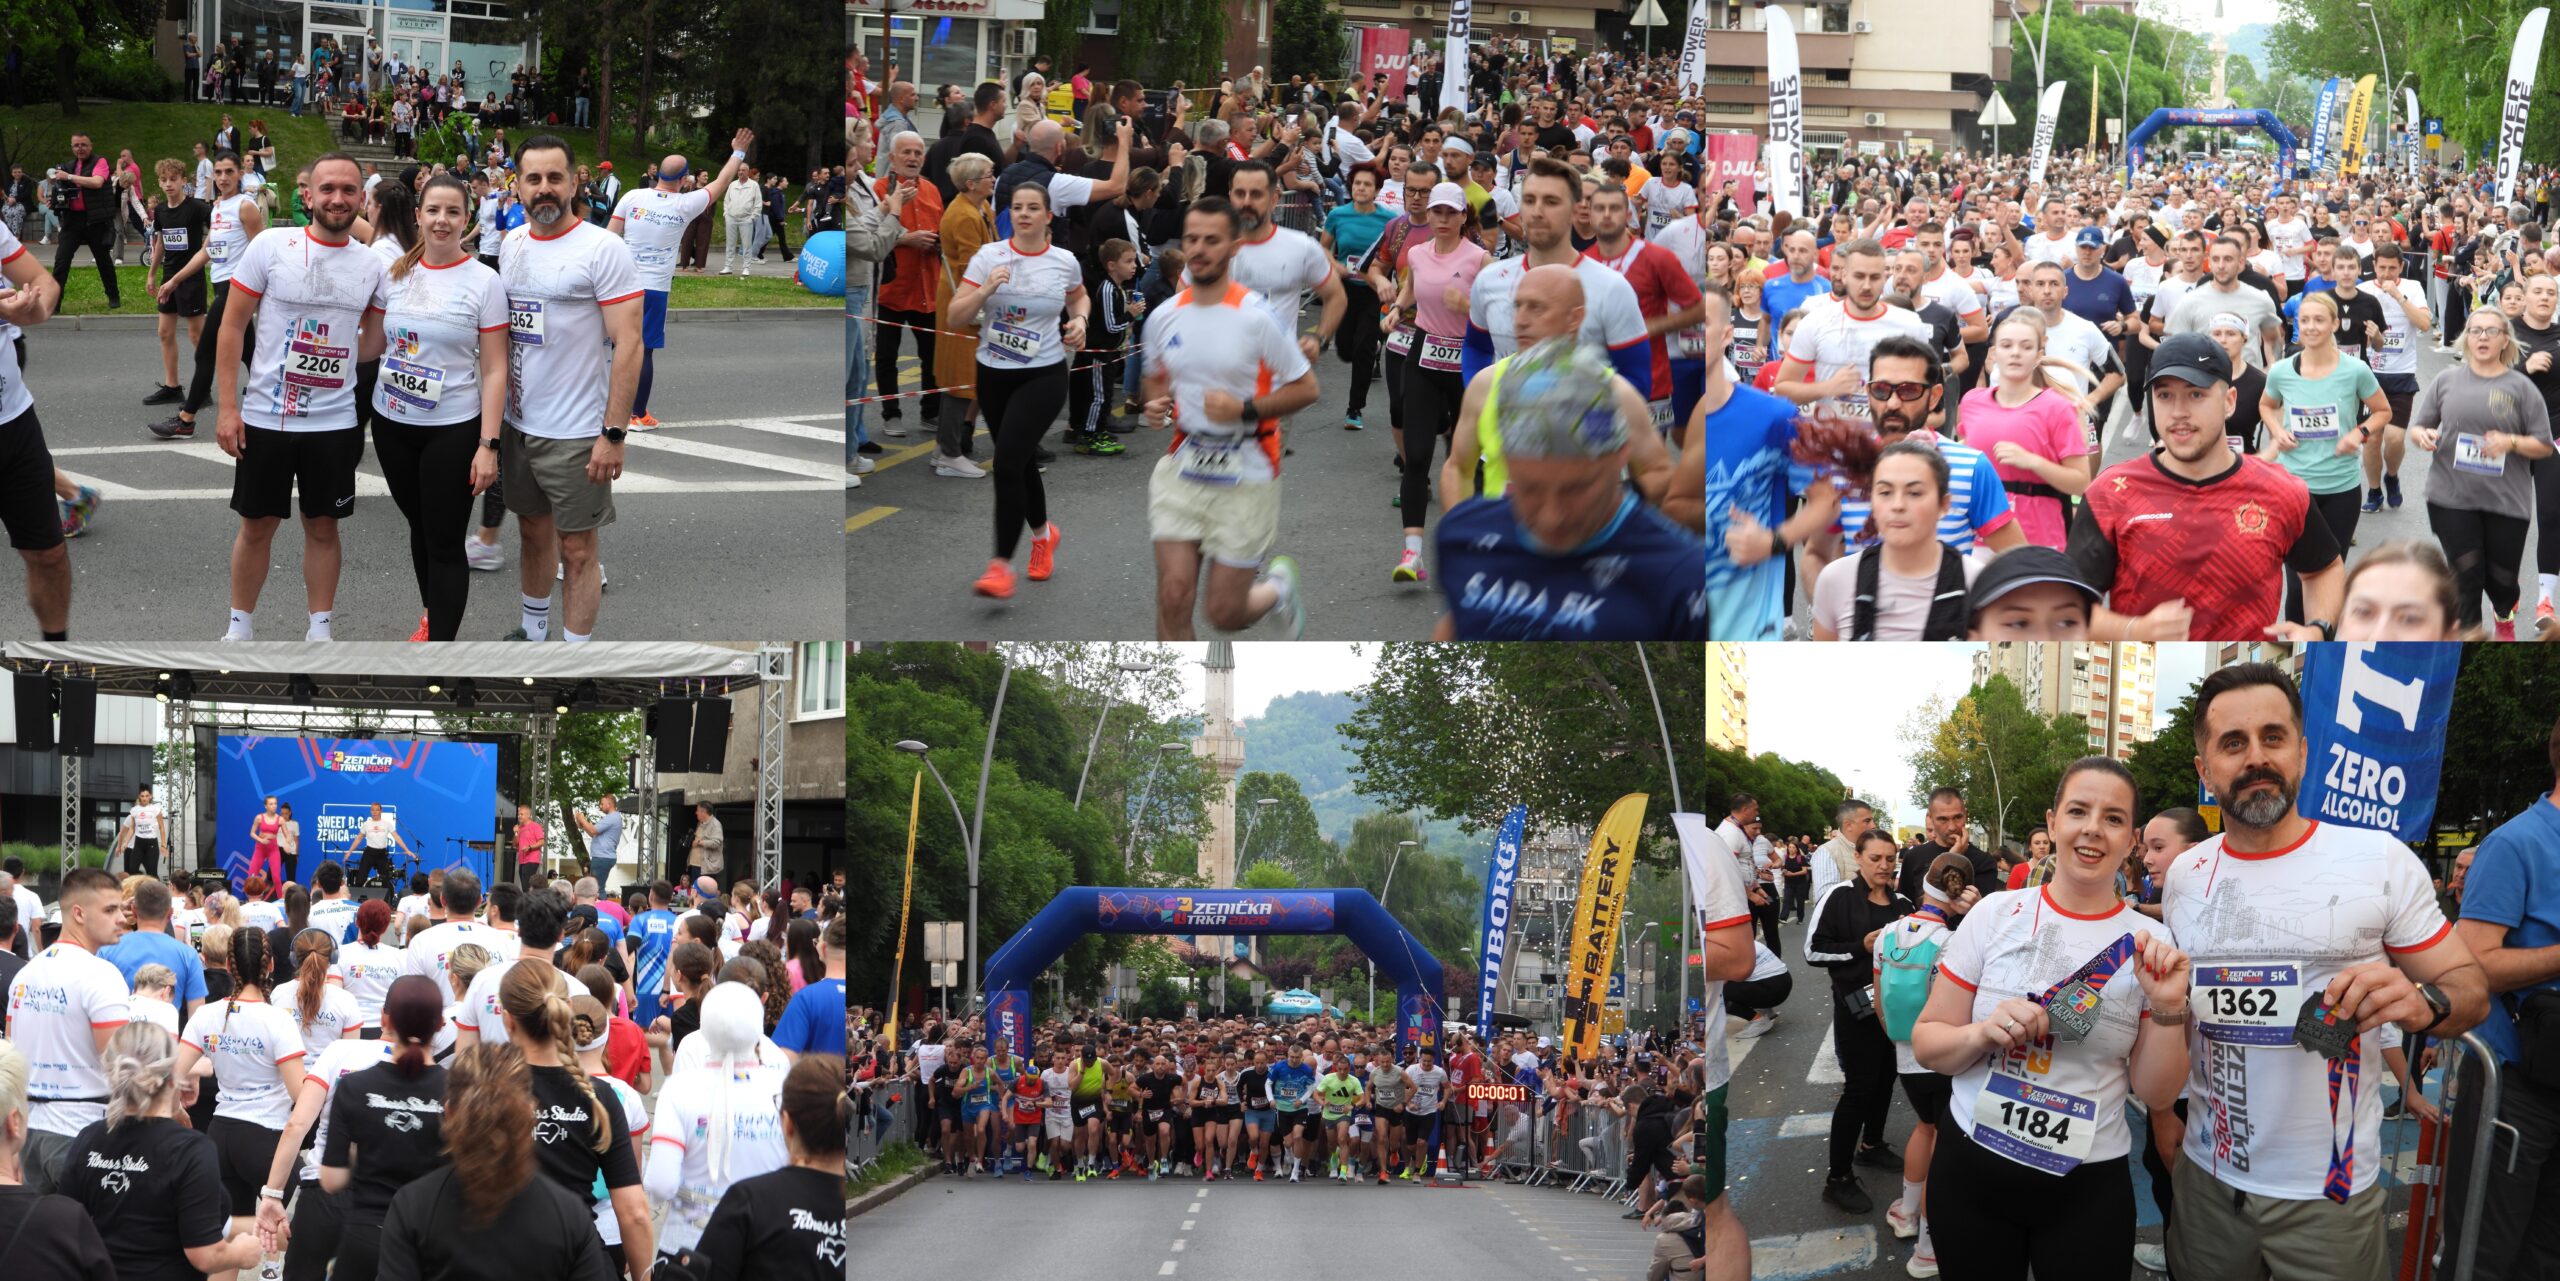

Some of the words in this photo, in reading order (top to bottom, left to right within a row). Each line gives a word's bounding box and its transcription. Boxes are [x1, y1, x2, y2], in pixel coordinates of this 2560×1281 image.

[1682, 16, 1703, 73] POWER
[2313, 91, 2334, 159] TUBORG
[2350, 91, 2366, 143] BATTERY
[2429, 121, 2438, 133] P
[2032, 114, 2049, 170] POWER
[2496, 78, 2522, 203] POWER
[164, 234, 183, 243] 1480
[801, 248, 829, 270] POWER
[998, 332, 1029, 351] 1184
[1430, 345, 1461, 359] 2077
[2383, 338, 2400, 346] 249
[296, 355, 340, 374] 2206
[392, 371, 428, 394] 1184
[2298, 416, 2330, 429] 1283
[339, 763, 364, 772] TRKA
[364, 765, 391, 773] 2026
[344, 754, 393, 766] ZENIČKA
[2324, 742, 2407, 806] ZERO
[317, 815, 346, 829] SWEET
[2320, 790, 2400, 831] ALCOHOL
[1193, 900, 1272, 915] ZENIČKA
[1585, 836, 1622, 976] BATTERY
[1186, 915, 1226, 925] TRKA
[1227, 916, 1269, 925] 2026
[1482, 841, 1517, 1021] TUBORG
[2228, 969, 2264, 978] ZENIČKA
[2270, 970, 2288, 982] 5K
[2207, 988, 2278, 1017] 1362
[1014, 1013, 1025, 1055] 2026
[2212, 1041, 2226, 1097] RKA
[1468, 1084, 1526, 1101] 00:00:01
[2031, 1089, 2069, 1105] ZENIČKA
[2072, 1102, 2088, 1115] 5K
[550, 1105, 589, 1122] Studio
[2226, 1044, 2255, 1174] ZENIČKA
[2000, 1101, 2071, 1145] 1184
[2212, 1096, 2231, 1164] 2026
[2006, 1129, 2021, 1141] Elma
[87, 1150, 121, 1170] Fitness
[121, 1154, 149, 1173] Studio
[789, 1207, 838, 1236] Fitness
